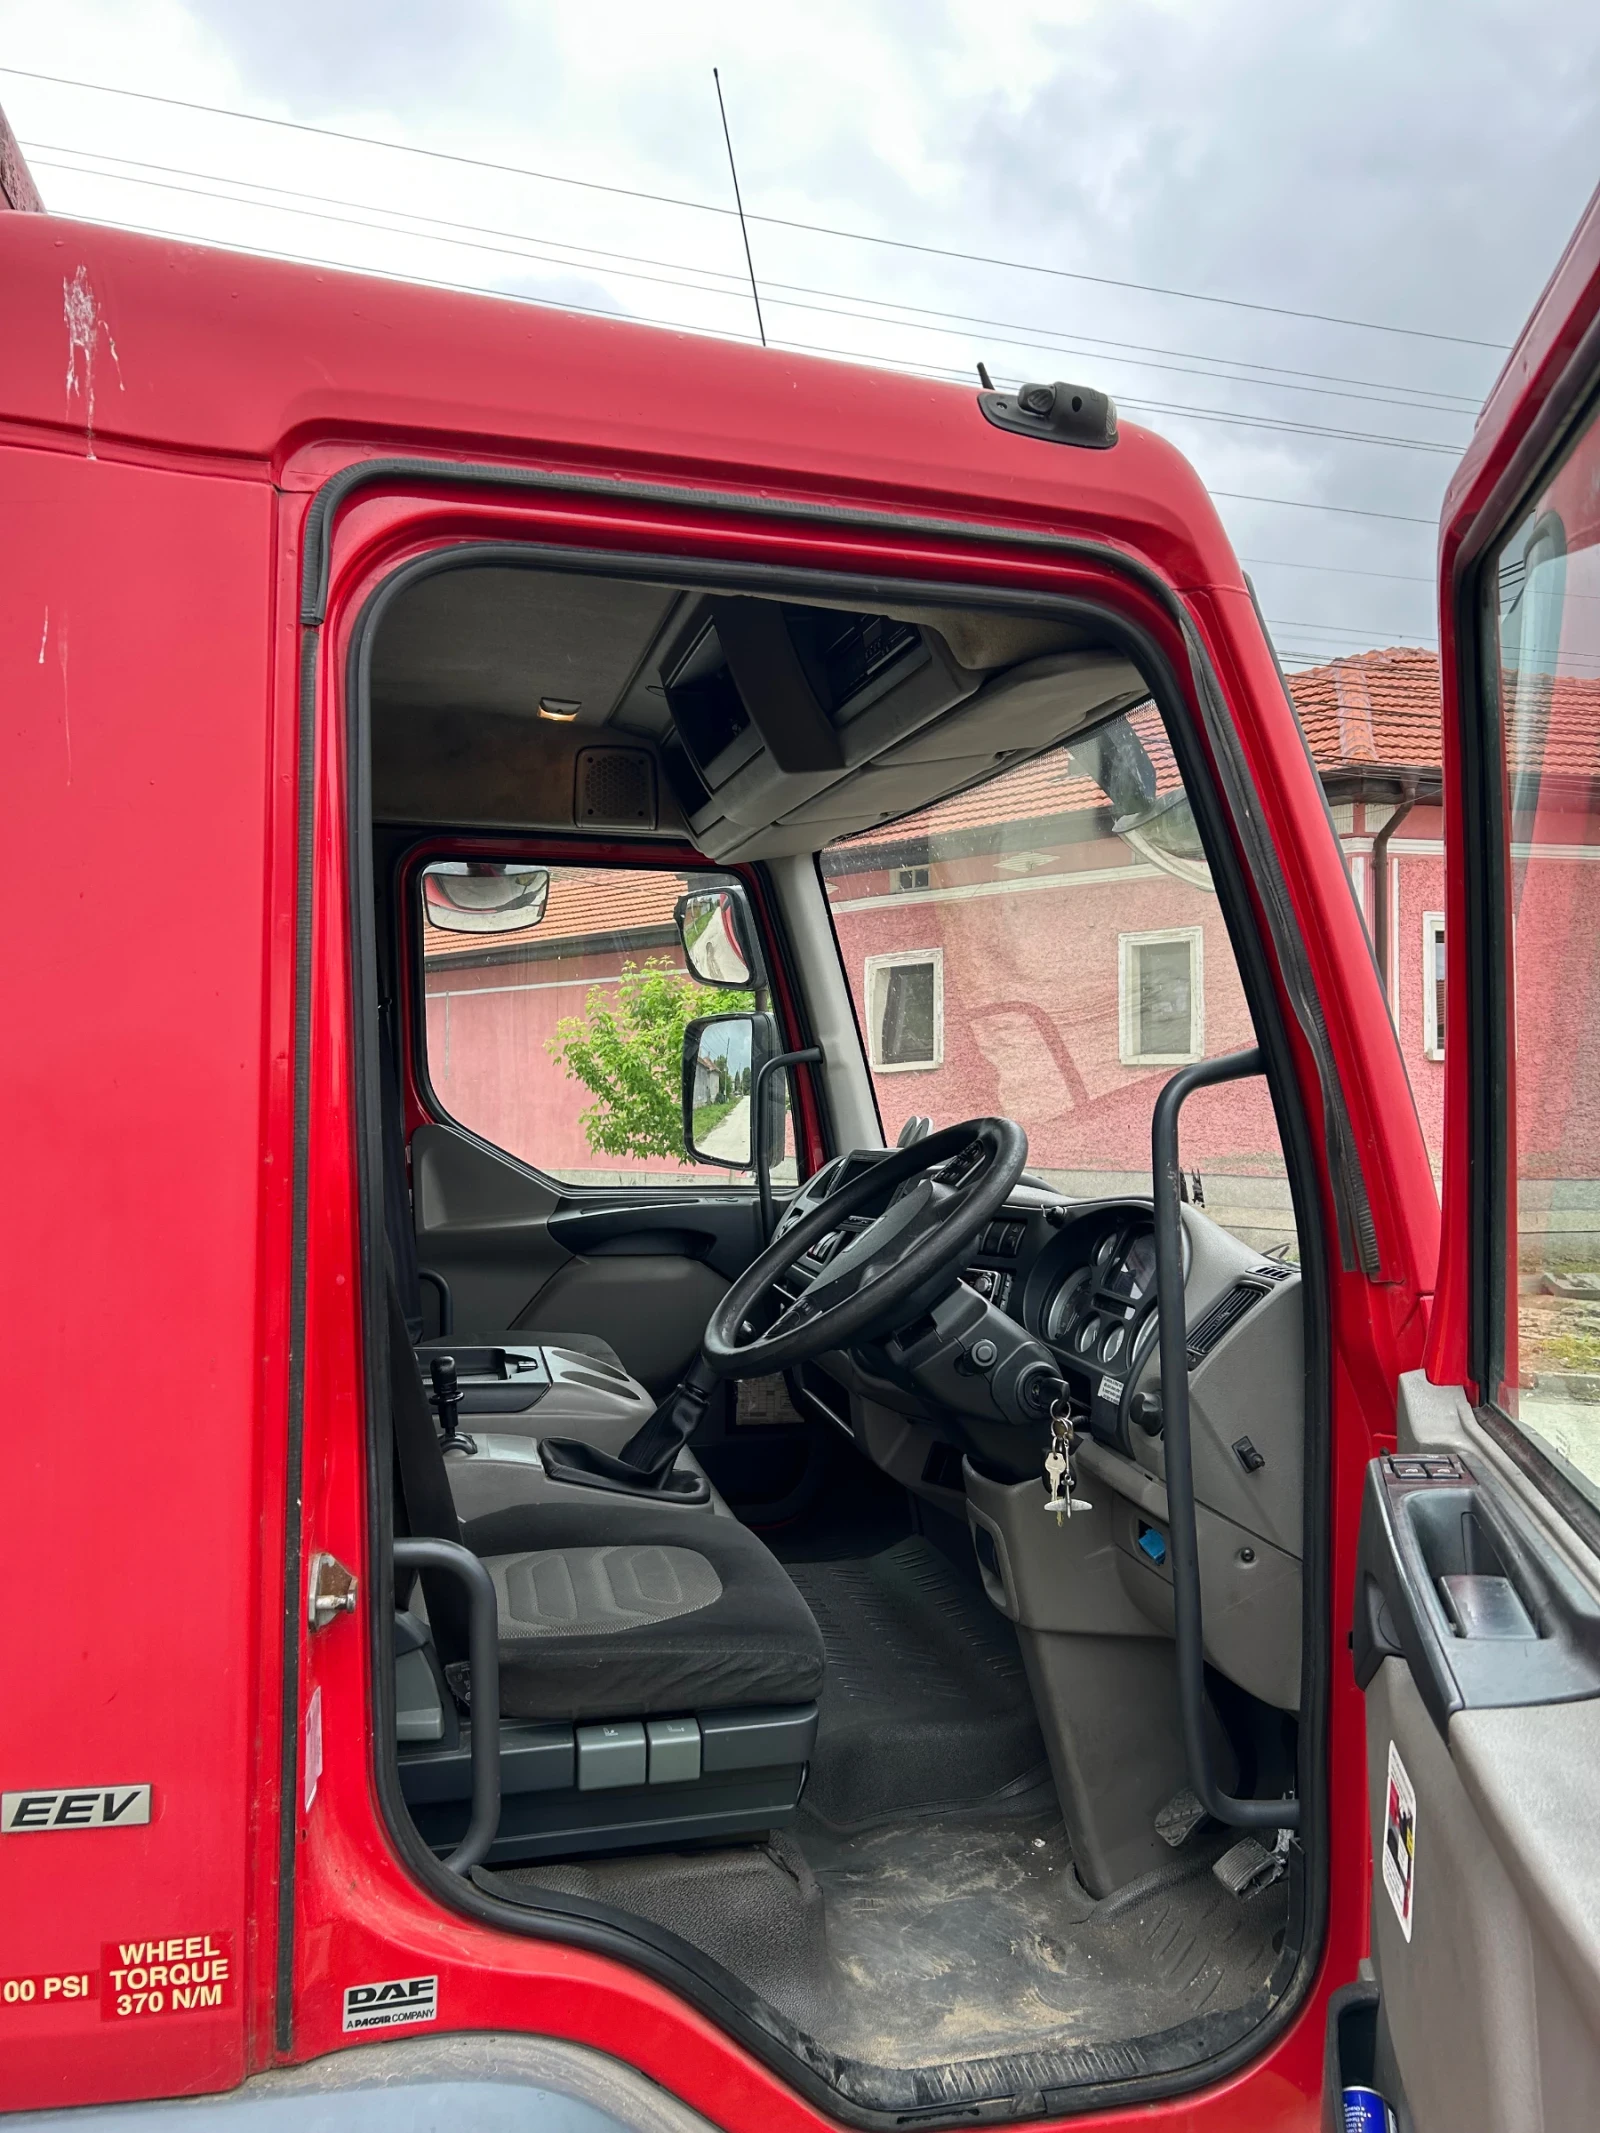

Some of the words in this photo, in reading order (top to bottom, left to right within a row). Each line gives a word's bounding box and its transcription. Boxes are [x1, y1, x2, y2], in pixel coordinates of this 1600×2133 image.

[10, 1791, 142, 1828] EEV
[119, 1935, 220, 1966] WHEEL
[0, 1979, 36, 2003] 00
[43, 1974, 88, 2000] PSI
[109, 1958, 229, 1992] TORQUE
[116, 1991, 164, 2016] 370
[172, 1984, 222, 2010] N/M
[348, 1978, 434, 2006] DAF
[346, 2020, 354, 2030] A
[354, 2015, 391, 2028] PACCAR
[391, 2009, 435, 2023] COMPANY
